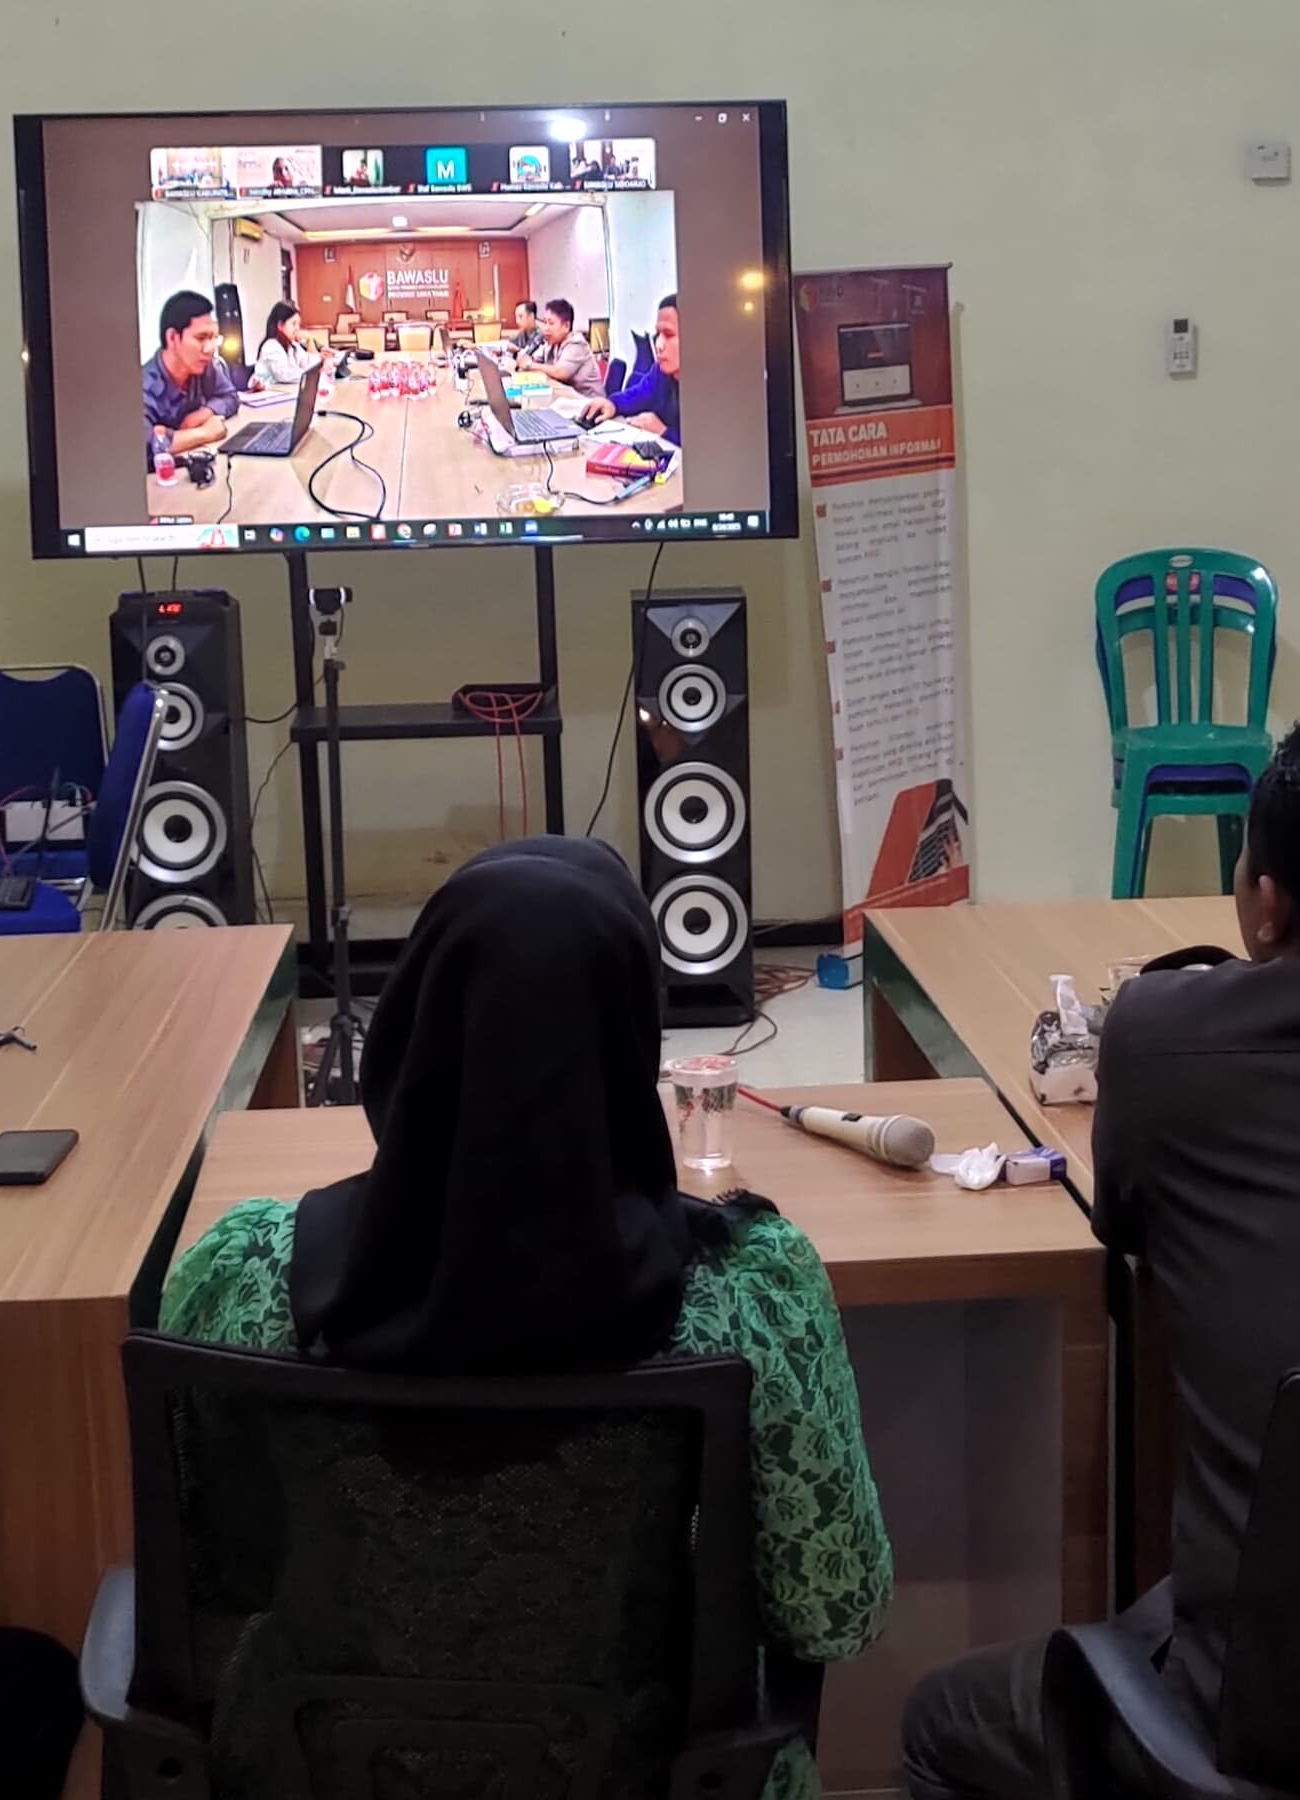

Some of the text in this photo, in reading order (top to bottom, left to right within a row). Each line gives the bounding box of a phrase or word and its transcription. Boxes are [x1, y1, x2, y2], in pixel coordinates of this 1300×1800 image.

[436, 160, 455, 179] M
[386, 268, 449, 285] BAWASLU
[809, 421, 888, 448] TATA CARA
[811, 445, 888, 467] PERMOHONAN
